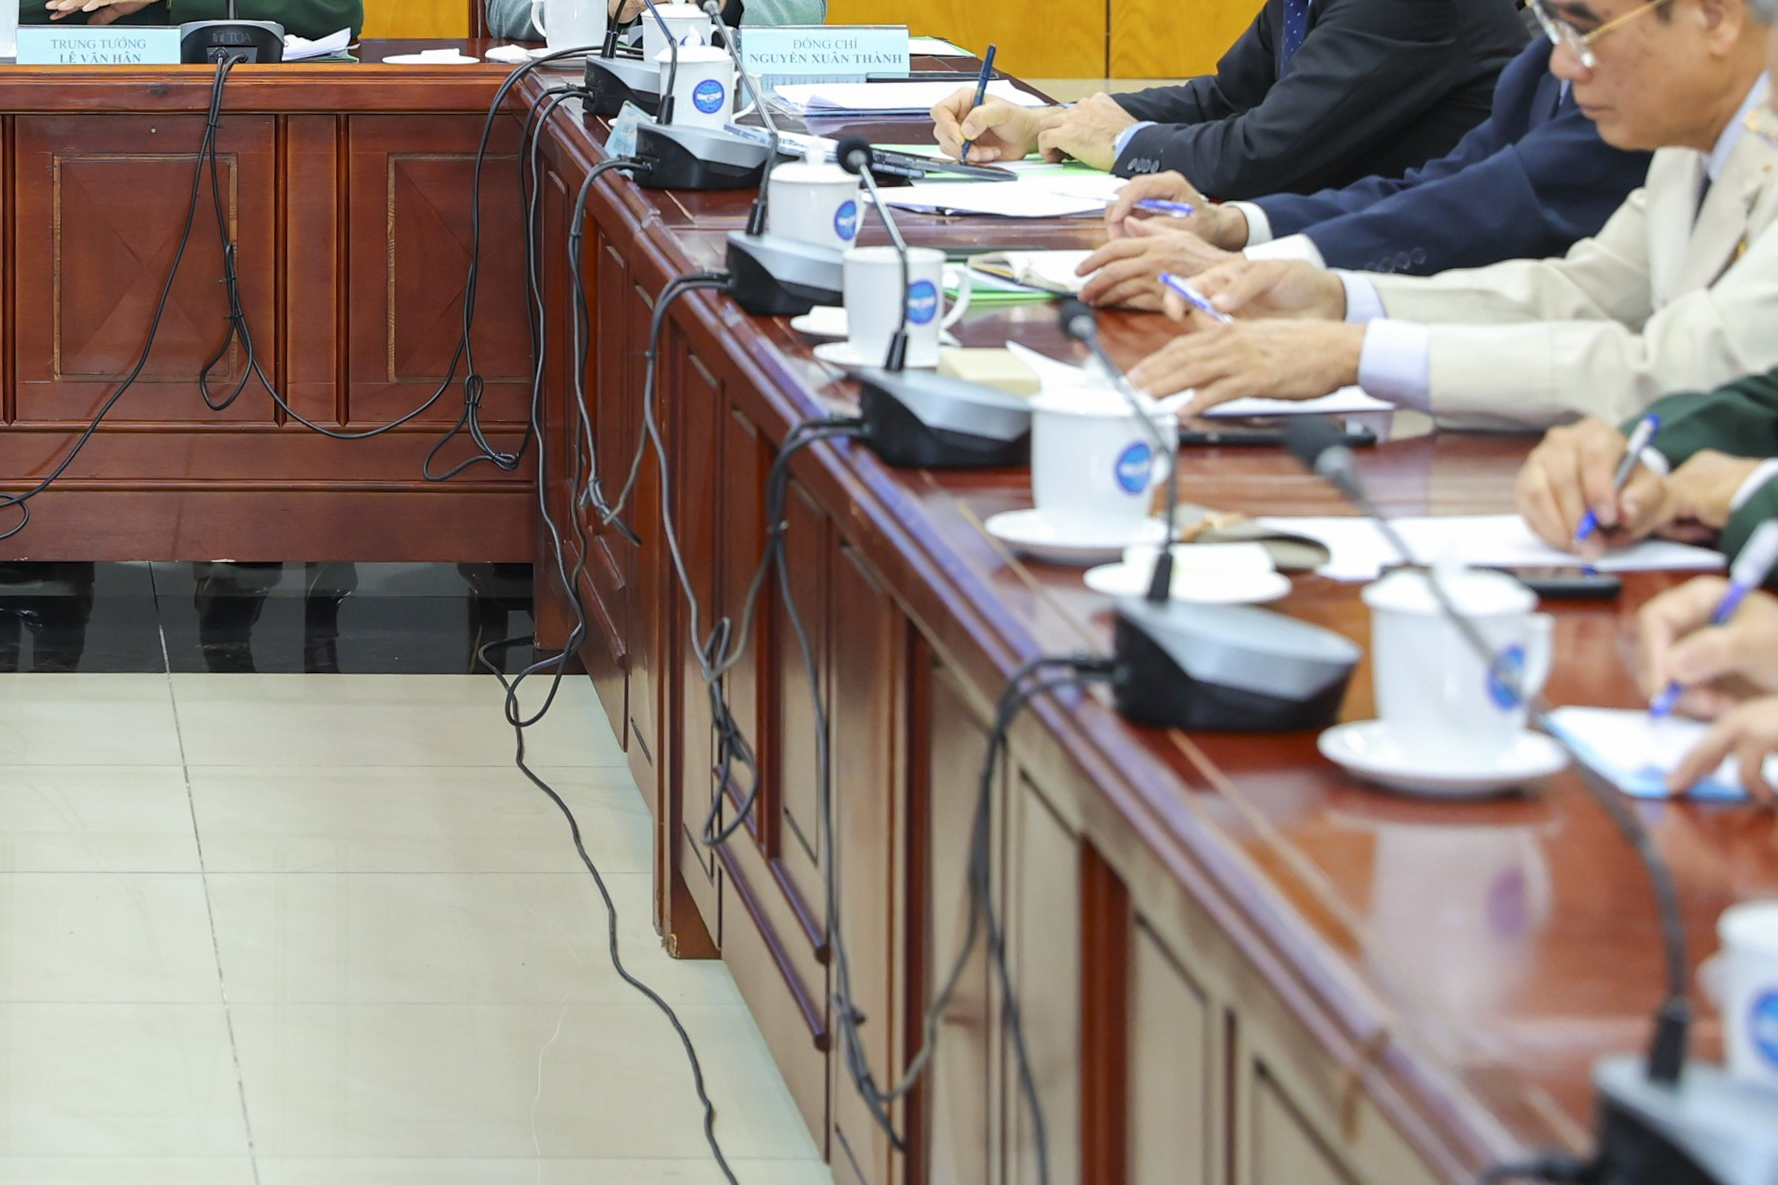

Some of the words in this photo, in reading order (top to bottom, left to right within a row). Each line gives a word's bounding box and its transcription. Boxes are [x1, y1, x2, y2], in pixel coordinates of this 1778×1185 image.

[50, 39, 96, 49] TRUNG
[99, 36, 146, 49] TƯỚNG
[793, 37, 831, 49] ĐỒNG
[835, 37, 858, 49] CHÍ
[59, 51, 77, 63] LÊ
[81, 51, 109, 63] VĂN
[113, 51, 141, 63] HÂN
[750, 51, 807, 63] NGUYỄN
[811, 51, 849, 63] XUÂN
[853, 51, 902, 63] THÀNH
